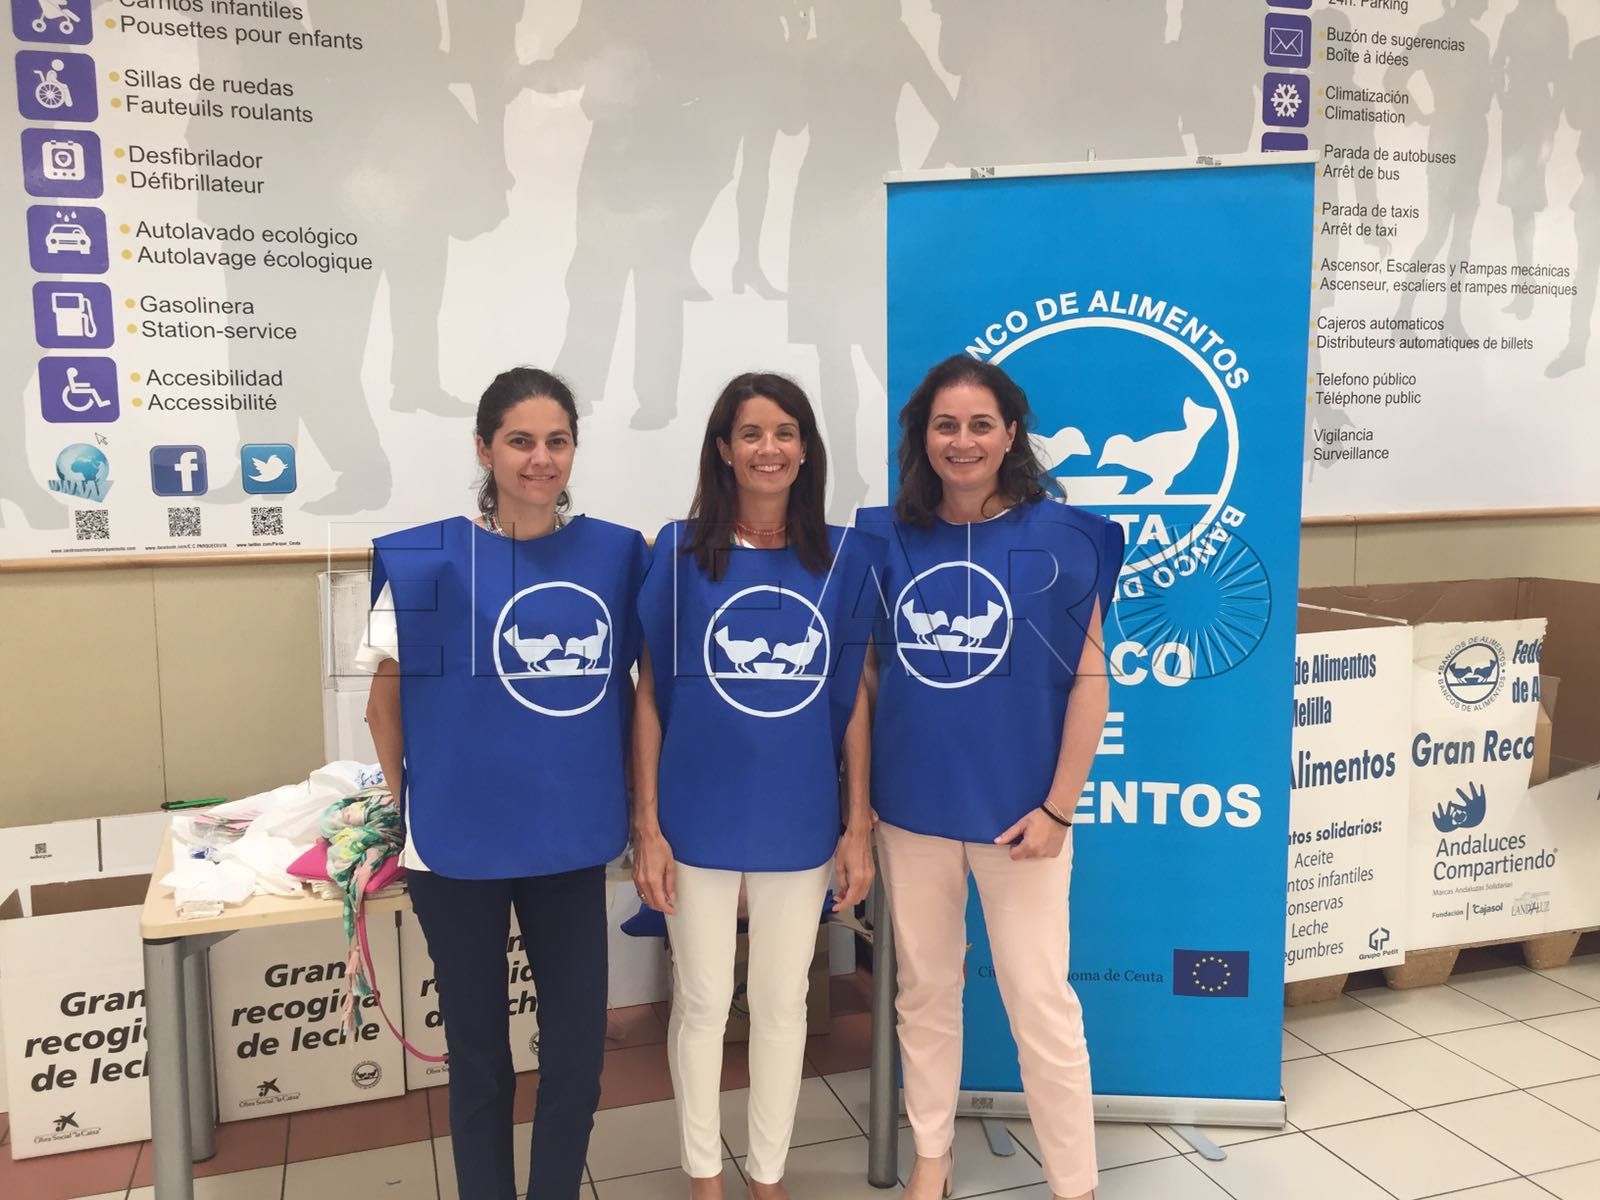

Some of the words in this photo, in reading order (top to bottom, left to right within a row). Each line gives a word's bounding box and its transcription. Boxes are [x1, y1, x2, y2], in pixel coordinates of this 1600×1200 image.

[211, 0, 303, 20] infantiles
[120, 15, 228, 39] Pousettes
[235, 27, 281, 45] pour
[288, 30, 363, 50] enfants
[1327, 27, 1367, 44] Buzón
[1371, 30, 1387, 45] de
[1391, 35, 1465, 52] sugerencias
[1326, 47, 1359, 63] Boîte
[1363, 49, 1371, 64] à
[1375, 51, 1408, 66] idées
[124, 69, 182, 90] Sillas
[189, 74, 215, 92] de
[222, 78, 294, 97] ruedas
[1325, 86, 1409, 105] Climatización
[126, 95, 224, 118] Fauteuils
[231, 103, 313, 123] roulants
[1325, 105, 1405, 124] Climatisation
[128, 145, 263, 169] Desfibrilador
[1324, 144, 1370, 161] Parada
[1373, 146, 1389, 162] de
[1392, 148, 1456, 165] autobuses
[130, 171, 265, 194] Défibrillateur
[1323, 164, 1354, 179] Arrêt
[1358, 166, 1374, 180] de
[1377, 166, 1400, 181] bus
[1322, 202, 1368, 218] Parada
[1371, 203, 1387, 218] de
[1391, 204, 1419, 219] taxis
[136, 221, 255, 242] Autolavado
[261, 226, 358, 249] ecológico
[1321, 222, 1352, 236] Arrêt
[1356, 223, 1371, 237] de
[1375, 223, 1397, 237] taxi
[137, 246, 257, 270] Autolavage
[263, 252, 373, 274] écologique
[1321, 258, 1382, 274] Ascensor,
[1387, 259, 1445, 274] Escaleras
[1449, 264, 1456, 277] y
[1460, 261, 1507, 277] Rampas
[1511, 262, 1570, 278] mecánicas
[1320, 277, 1389, 293] Ascenseur,
[1393, 278, 1446, 293] escaliers
[1450, 280, 1462, 293] et
[1464, 281, 1507, 297] rampes
[1511, 282, 1577, 297] mécaniques
[140, 295, 255, 314] Gasolinera
[142, 320, 297, 340] Station-service
[1317, 316, 1366, 332] Cajeros
[1370, 317, 1444, 331] automaticos
[965, 310, 1028, 361] NCO
[1036, 291, 1079, 322] DE
[1088, 290, 1249, 389] ALIMENTOS
[1317, 335, 1395, 349] Distributeurs
[1399, 335, 1479, 351] automatiques
[1483, 336, 1498, 350] de
[1501, 336, 1533, 350] billets
[146, 369, 283, 387] Accesibilidad
[1317, 372, 1369, 386] Telefono
[1373, 371, 1416, 389] público
[148, 393, 277, 411] Accessibilité
[1316, 391, 1381, 406] Téléphone
[1385, 391, 1421, 406] public
[1314, 428, 1373, 445] Vigilancia
[1313, 446, 1389, 460] Surveillance
[1153, 505, 1246, 588] BANCO
[1468, 636, 1478, 644] DE
[1312, 652, 1376, 683] Alimentos
[1437, 679, 1461, 709] BANCOS
[1461, 704, 1471, 712] DE
[1512, 677, 1529, 703] de
[1412, 732, 1475, 767] Gran
[1070, 781, 1262, 828] ENTOS
[1316, 818, 1382, 842] solidarios:
[1436, 833, 1526, 857] Andaluces
[1294, 850, 1334, 868] Aceite
[1318, 866, 1374, 889] infantiles
[1286, 896, 1343, 916] onservas
[1473, 902, 1504, 915] Cajasol
[1291, 919, 1328, 939] Leche
[1284, 941, 1344, 966] gumbres
[1359, 951, 1381, 960] Grupo
[1383, 948, 1399, 957] Petit
[264, 961, 346, 988] Gran
[1104, 969, 1120, 981] de
[1124, 970, 1164, 983] Ceuta
[60, 989, 146, 1017] Gran
[231, 988, 380, 1027] recogia
[25, 1017, 148, 1058] recogi
[237, 1032, 279, 1059] de
[31, 1064, 77, 1092] de
[90, 1051, 149, 1084] lec
